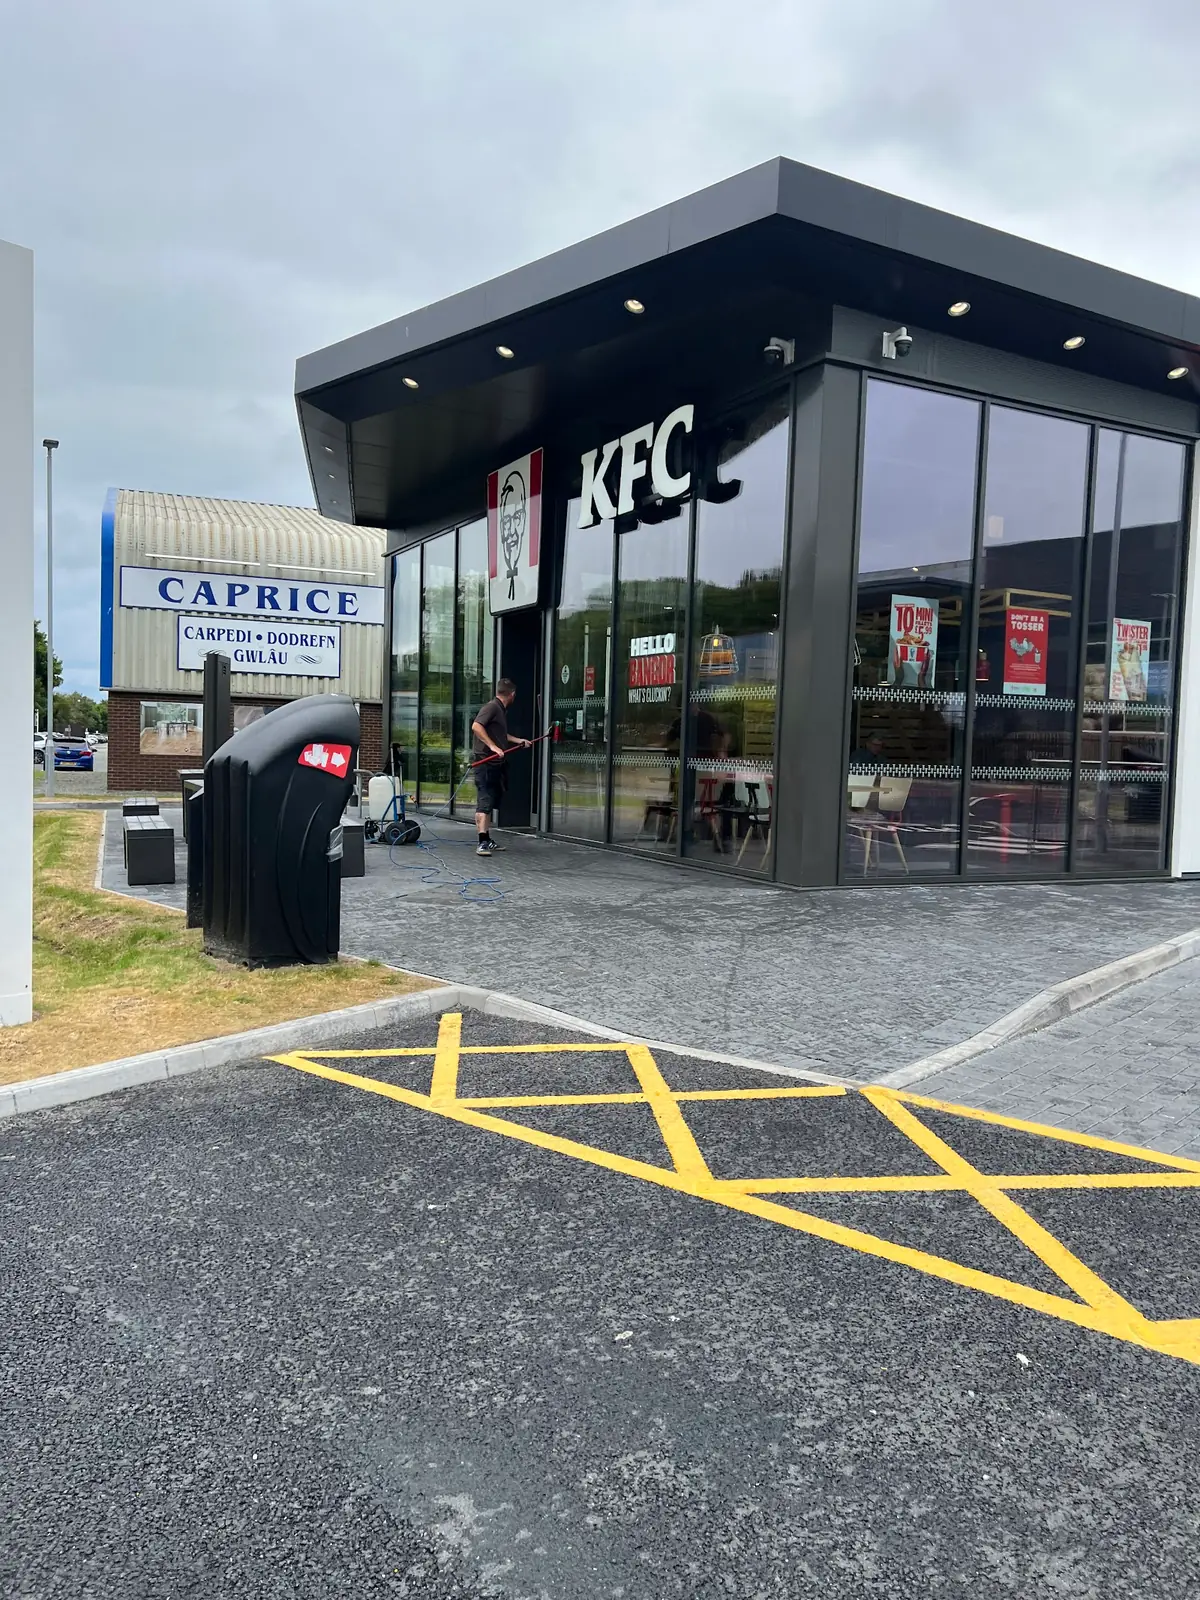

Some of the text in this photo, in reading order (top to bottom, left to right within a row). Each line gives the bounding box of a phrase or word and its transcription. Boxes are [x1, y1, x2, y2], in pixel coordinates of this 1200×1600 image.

[576, 404, 695, 529] KFC
[158, 577, 359, 616] CAPRICE
[895, 605, 934, 633] 10 MINI
[1011, 621, 1044, 631] TOSSER
[184, 626, 335, 648] CARPEDI DODREFN
[1117, 623, 1149, 640] TWISTER
[631, 633, 675, 657] HELLO
[234, 648, 288, 665] GWLÂU
[628, 688, 646, 703] WHAT'S
